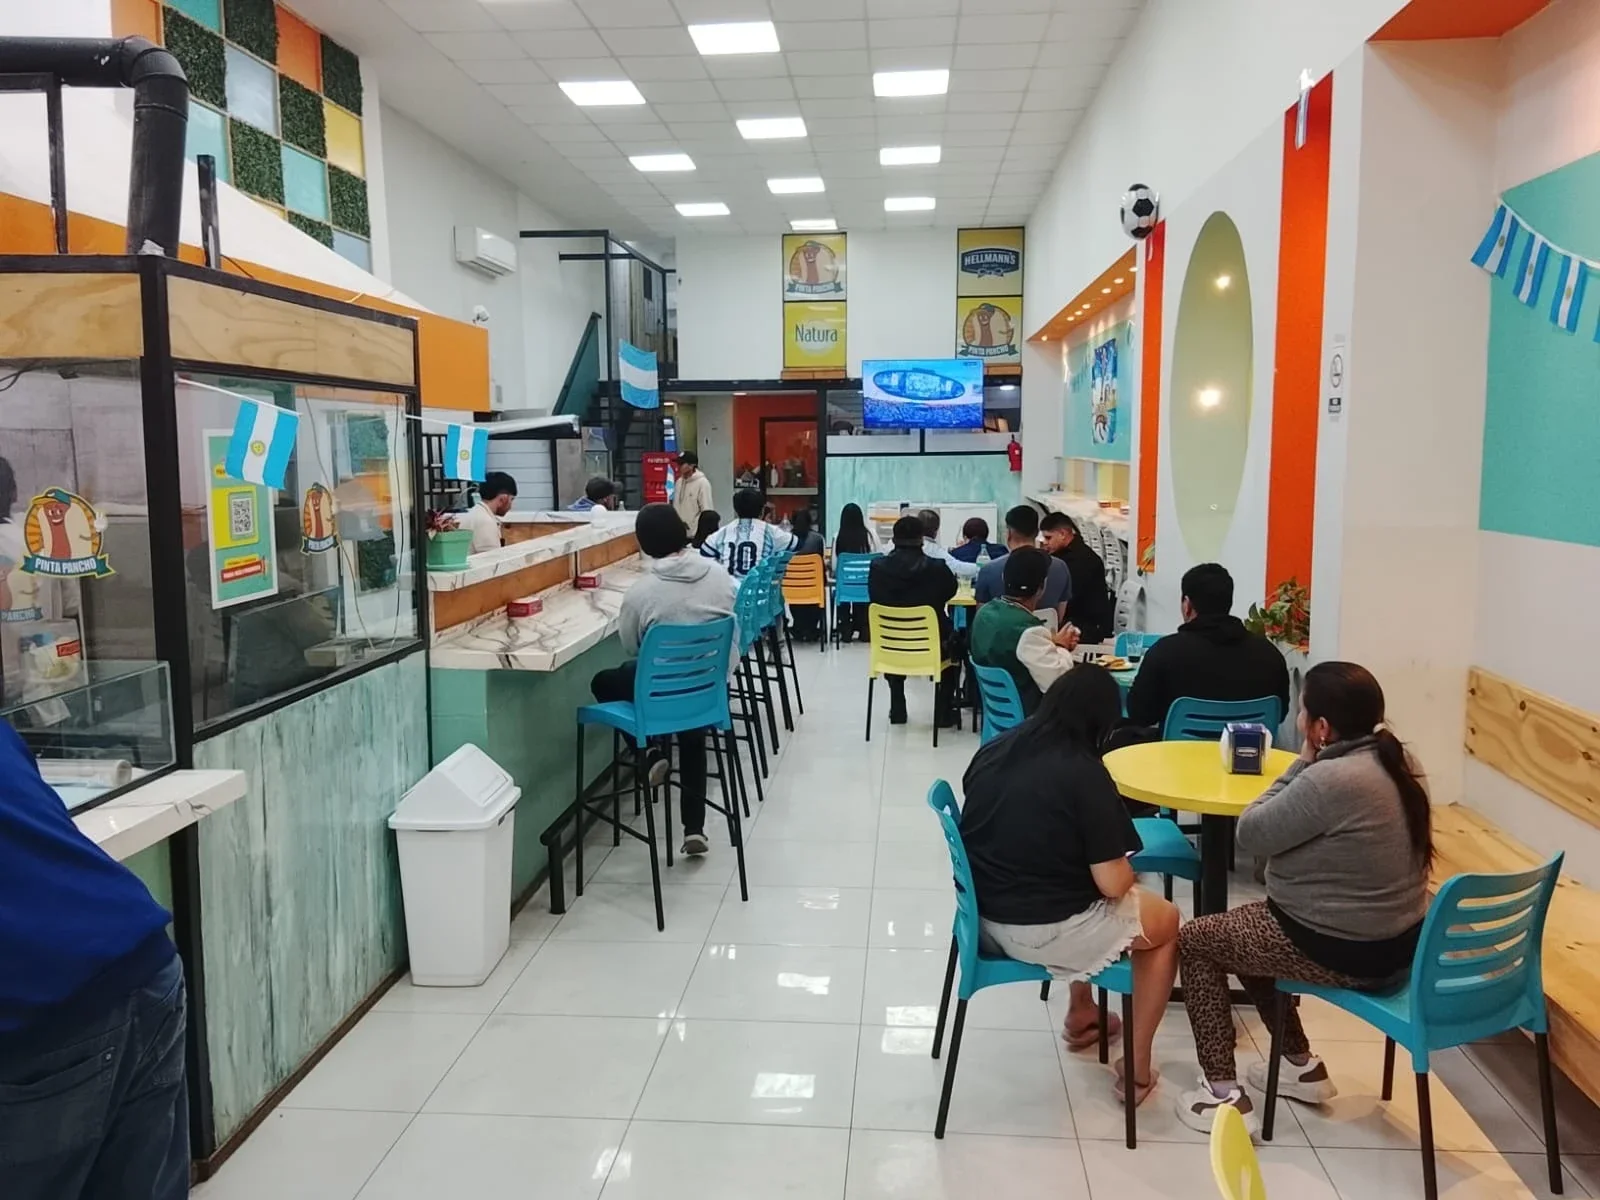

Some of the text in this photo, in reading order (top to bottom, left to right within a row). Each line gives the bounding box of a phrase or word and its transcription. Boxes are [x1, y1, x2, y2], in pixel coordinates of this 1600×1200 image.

[964, 252, 1016, 266] HELLMANN'S
[795, 323, 838, 342] Natura
[34, 558, 97, 574] PINTA PANCHO
[727, 541, 757, 575] 10
